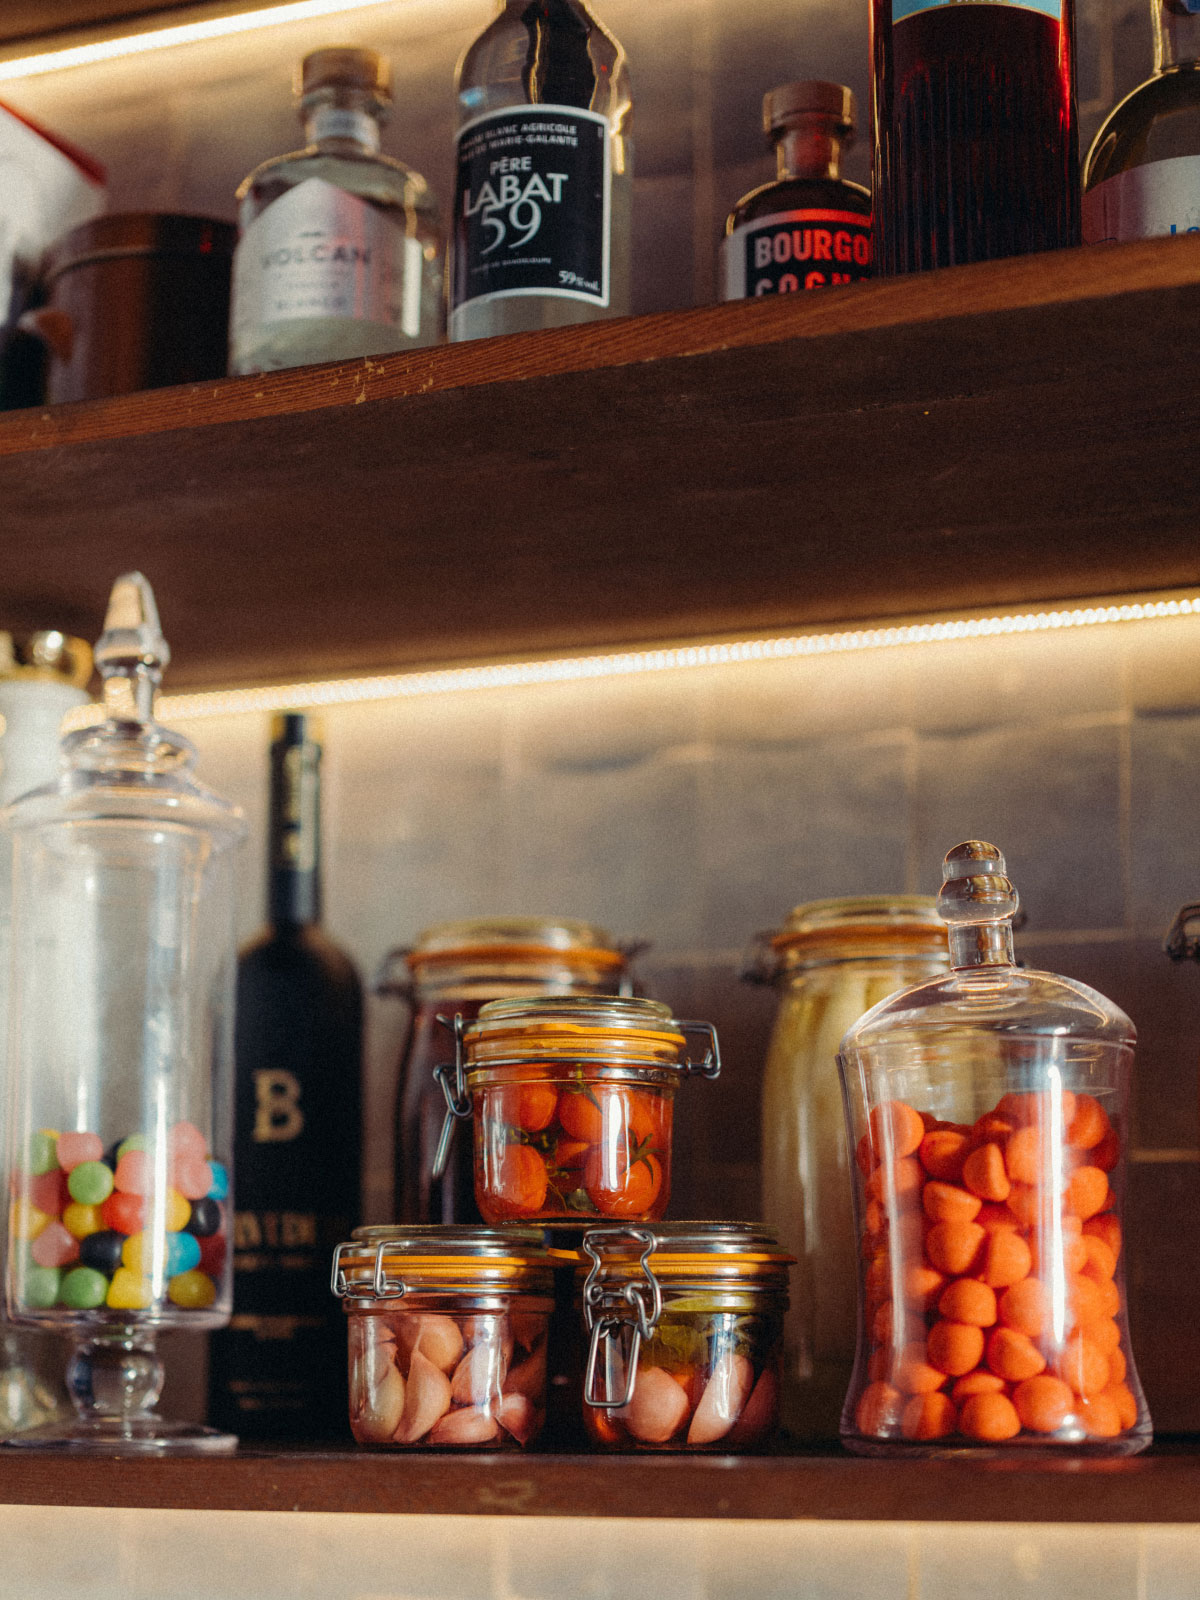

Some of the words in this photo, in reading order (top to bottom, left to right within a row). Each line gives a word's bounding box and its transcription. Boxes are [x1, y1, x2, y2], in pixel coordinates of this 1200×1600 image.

[489, 134, 579, 148] MARIE-GALANTE
[521, 122, 577, 136] AGRICOLE
[490, 155, 532, 175] PÈRE
[464, 172, 569, 216] LABAT
[481, 199, 542, 255] 59
[755, 229, 872, 270] BOURGO
[755, 271, 869, 297] COG
[253, 1068, 303, 1143] B
